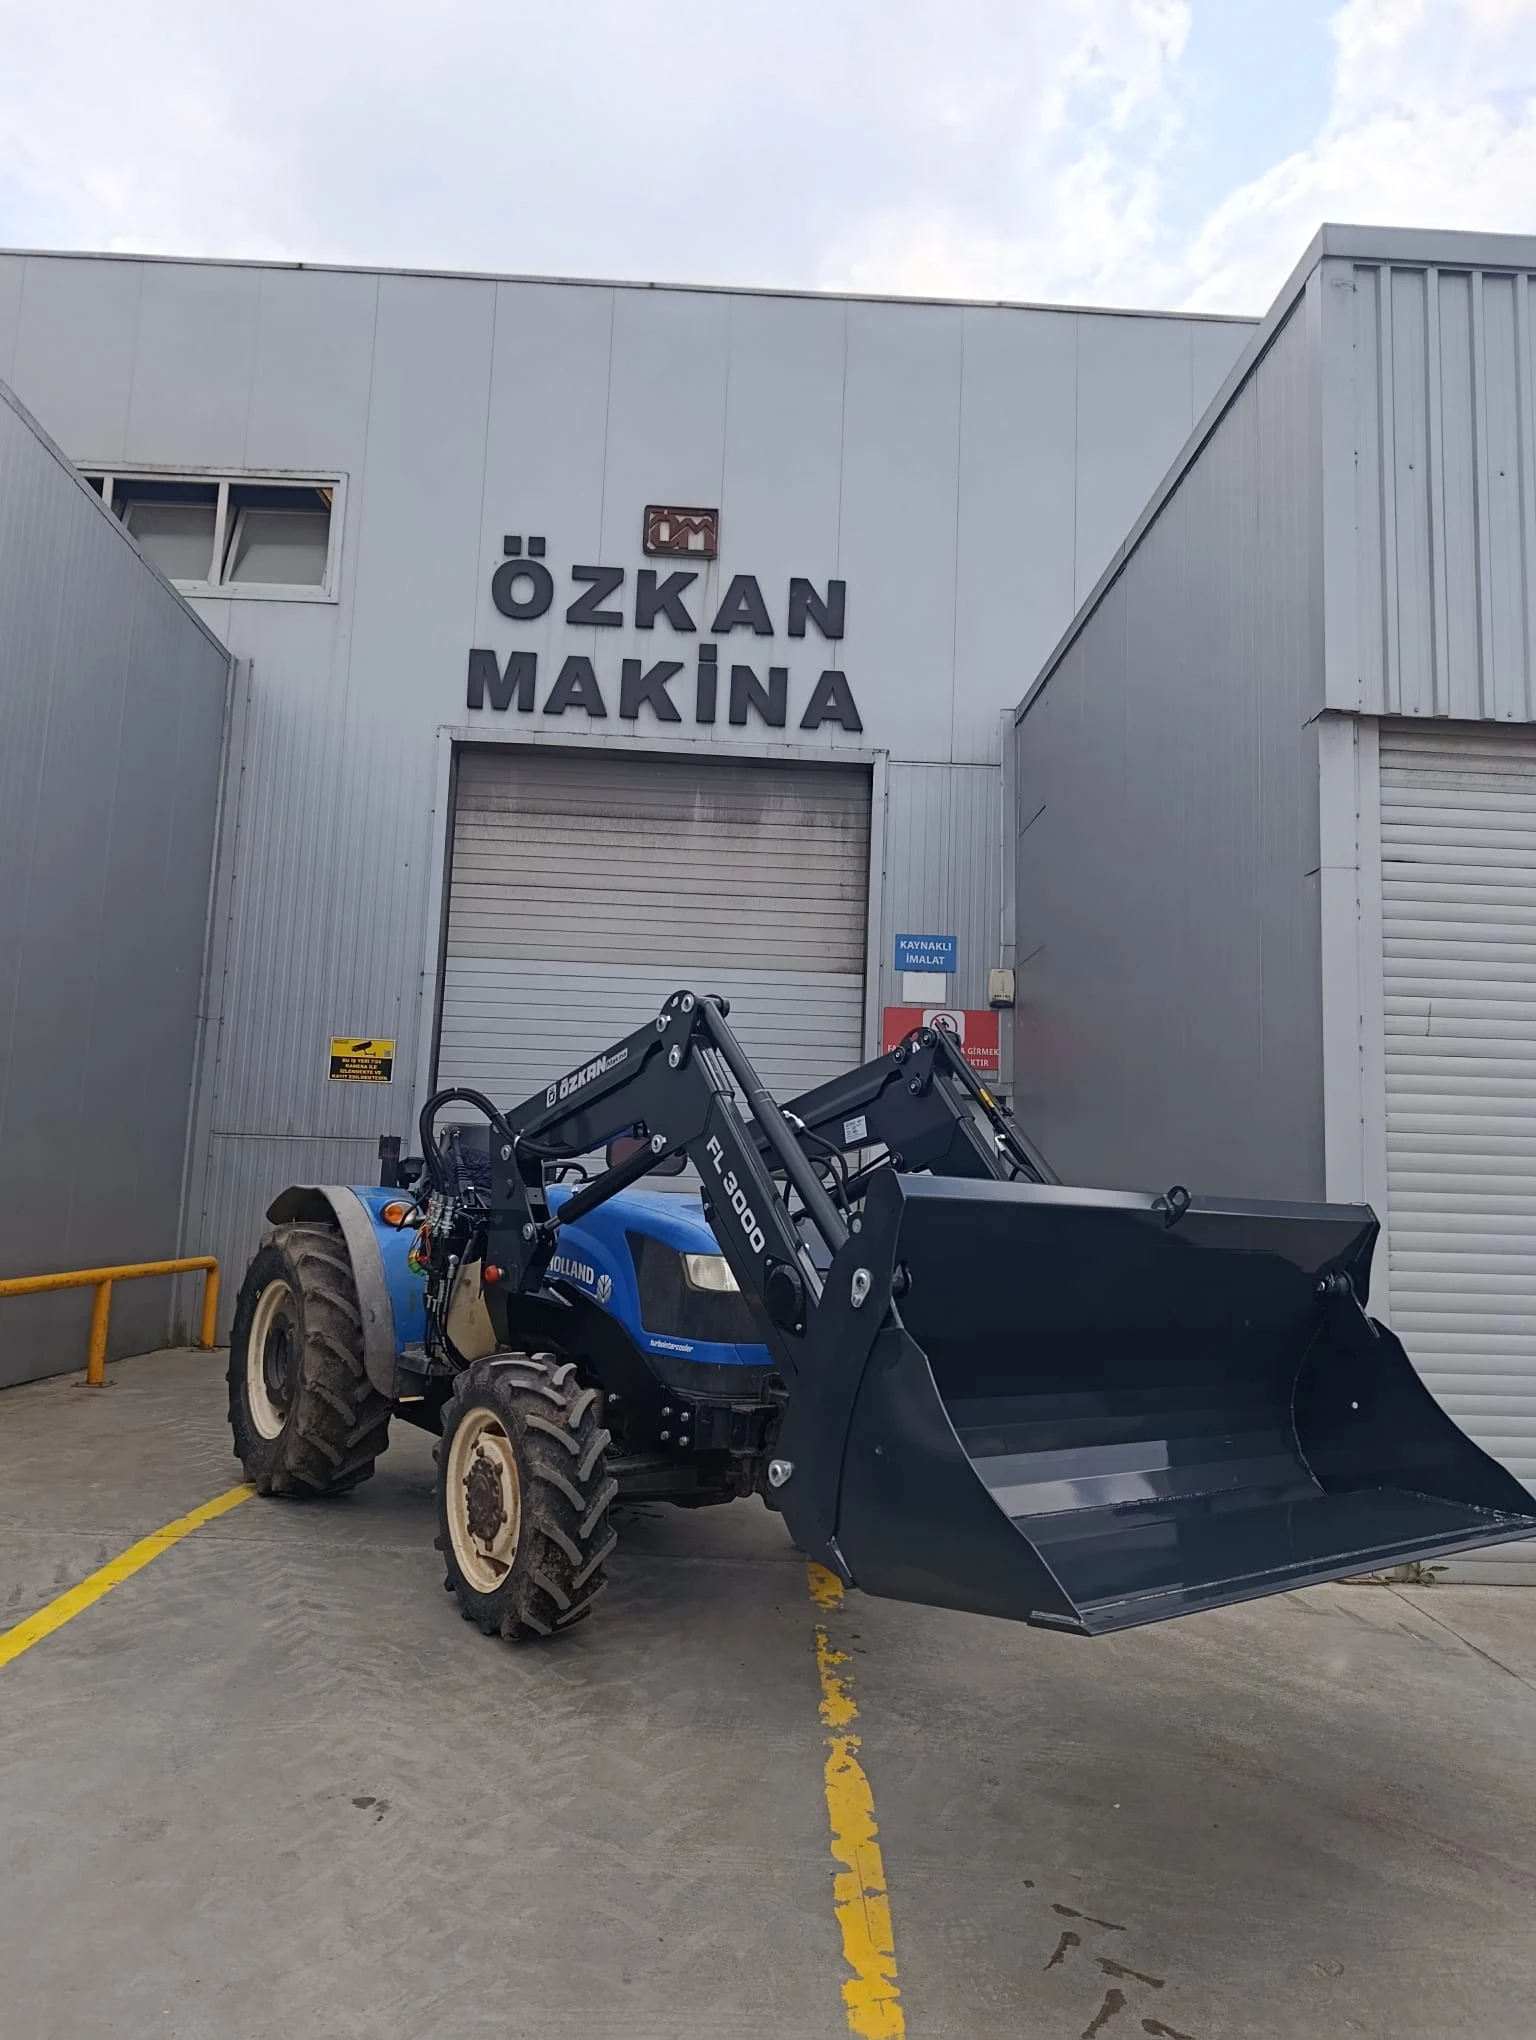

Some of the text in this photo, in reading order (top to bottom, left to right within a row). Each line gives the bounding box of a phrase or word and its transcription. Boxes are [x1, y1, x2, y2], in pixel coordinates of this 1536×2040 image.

[492, 535, 847, 639] ÖZKAN
[467, 643, 864, 732] MAKİNA
[900, 940, 952, 952] KAYNAKLI
[906, 953, 945, 965] İMALAT
[559, 1055, 607, 1100] ÖZKAN
[706, 1135, 766, 1254] FL 3000
